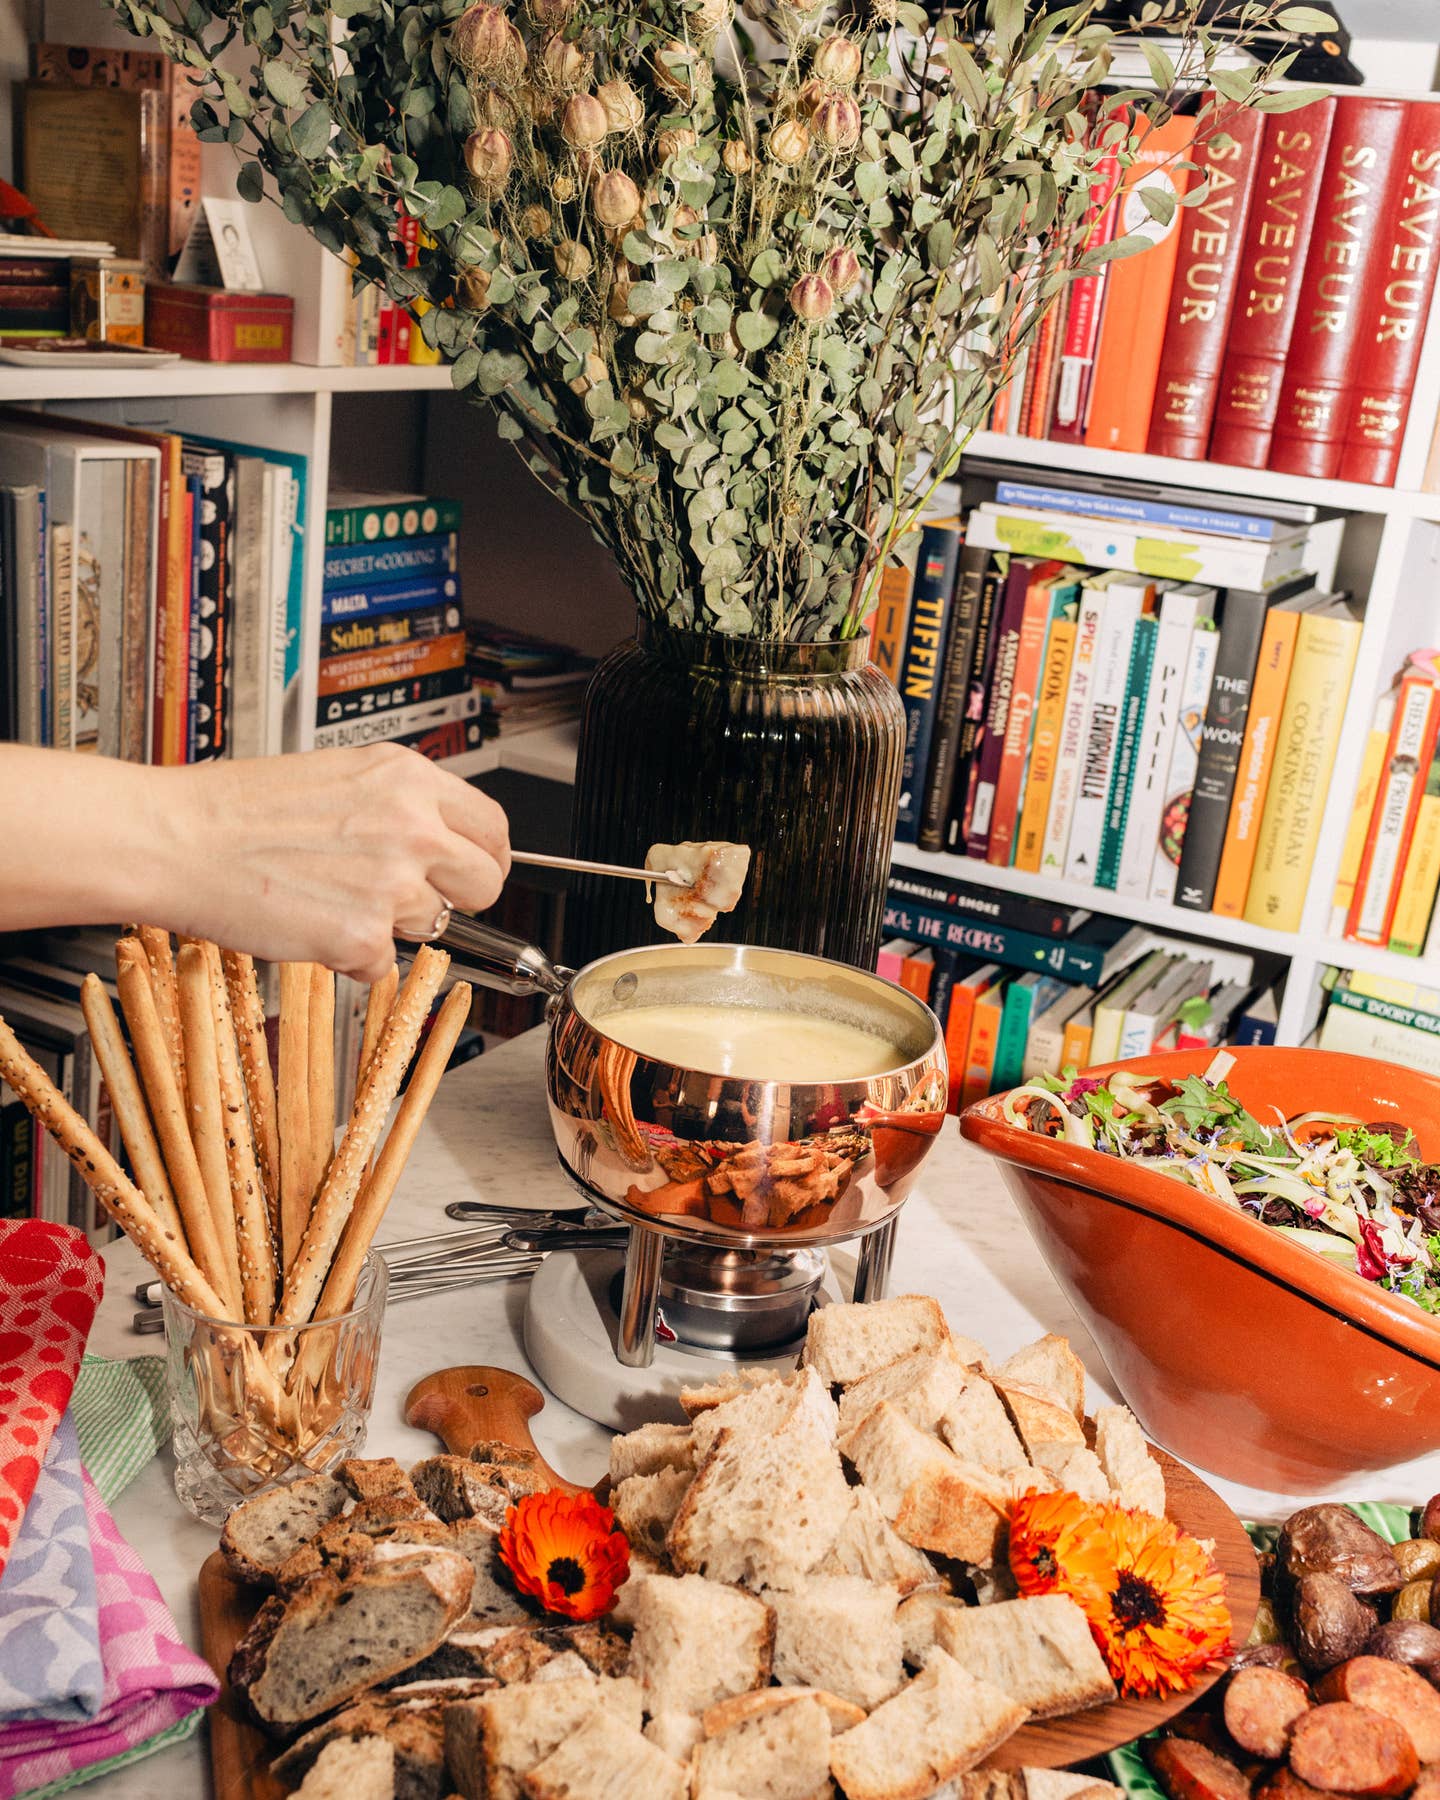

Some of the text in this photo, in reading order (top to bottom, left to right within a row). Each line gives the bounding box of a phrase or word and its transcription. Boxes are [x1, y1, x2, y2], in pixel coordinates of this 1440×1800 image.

[1179, 140, 1242, 324] SAVEUR
[1246, 130, 1312, 317] SAVEUR
[1311, 144, 1377, 333] SAVEUR
[1376, 148, 1440, 343] SAVEUR
[58, 542, 71, 584] PAUL
[325, 555, 374, 579] SECRET
[382, 549, 436, 572] COOKING
[58, 591, 71, 656] GALLICO
[189, 614, 201, 631] THE
[331, 594, 368, 615] MALTA
[958, 586, 980, 620] Am
[189, 632, 200, 658] STORY
[331, 618, 410, 653] Sohn-mat
[905, 598, 945, 700] TIFFIN
[950, 626, 972, 676] From
[1077, 610, 1099, 663] SPICE
[59, 664, 71, 694] THE
[327, 687, 407, 721] DINER
[991, 629, 1021, 737] A TASTE OF INDIA
[1073, 671, 1089, 697] AT
[1215, 675, 1248, 695] THE
[904, 708, 923, 749] SONAL
[942, 683, 964, 728] Here
[1004, 691, 1032, 758] Chaat
[1031, 636, 1069, 784] I COOK COLOR
[1404, 690, 1428, 751] CHEESE
[315, 730, 335, 749] ISH
[338, 715, 401, 747] BUTCHERY
[1063, 702, 1085, 760] HOME
[1080, 702, 1118, 800] FLAVORWALLA
[1203, 727, 1243, 745] WOK
[1247, 715, 1271, 781] Vegetable
[1280, 701, 1311, 795] COOKING
[1235, 783, 1257, 839] Kingdom
[1286, 734, 1324, 868] VEGETARIAN
[1385, 779, 1408, 837] PRIMER
[887, 877, 1001, 917] FRANKLIN SMOKE
[917, 915, 945, 939] THE
[946, 923, 1006, 953] RECIPES
[1341, 992, 1364, 1009] THE
[1366, 999, 1415, 1024] DOOKY
